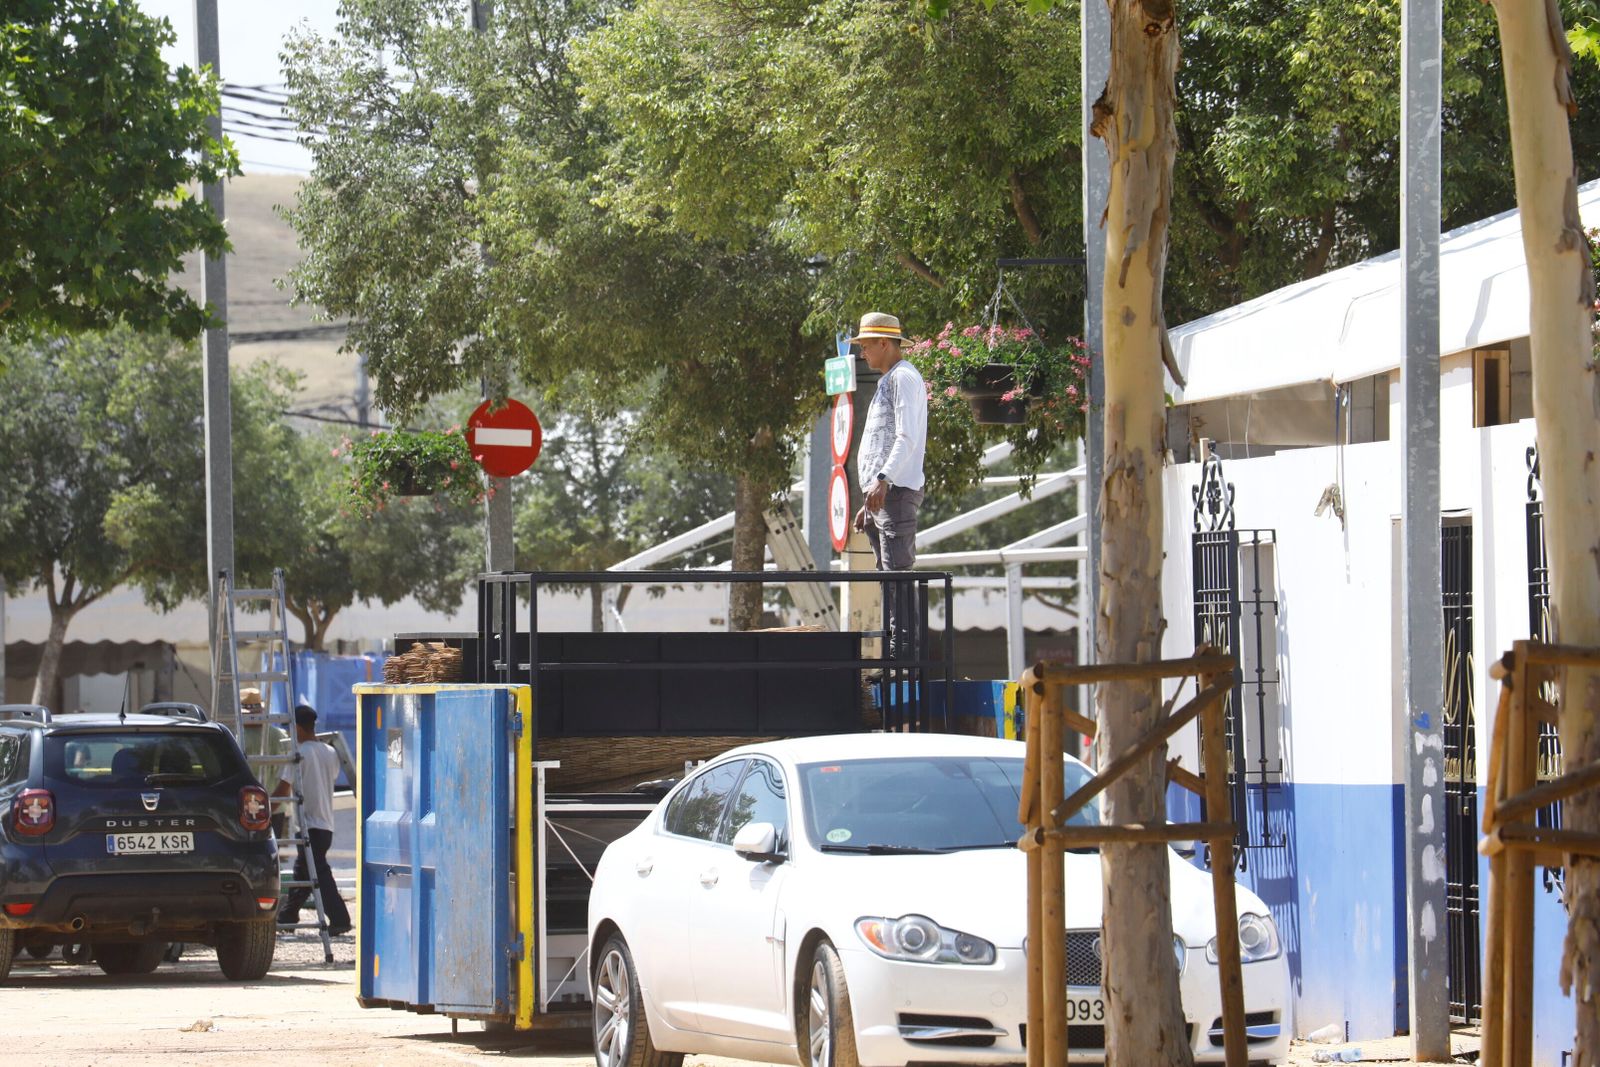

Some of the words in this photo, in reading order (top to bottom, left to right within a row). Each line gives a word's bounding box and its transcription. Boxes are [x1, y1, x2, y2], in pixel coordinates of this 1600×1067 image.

[106, 819, 195, 827] DUSTER
[117, 835, 156, 850] 6542
[161, 835, 189, 849] KSR
